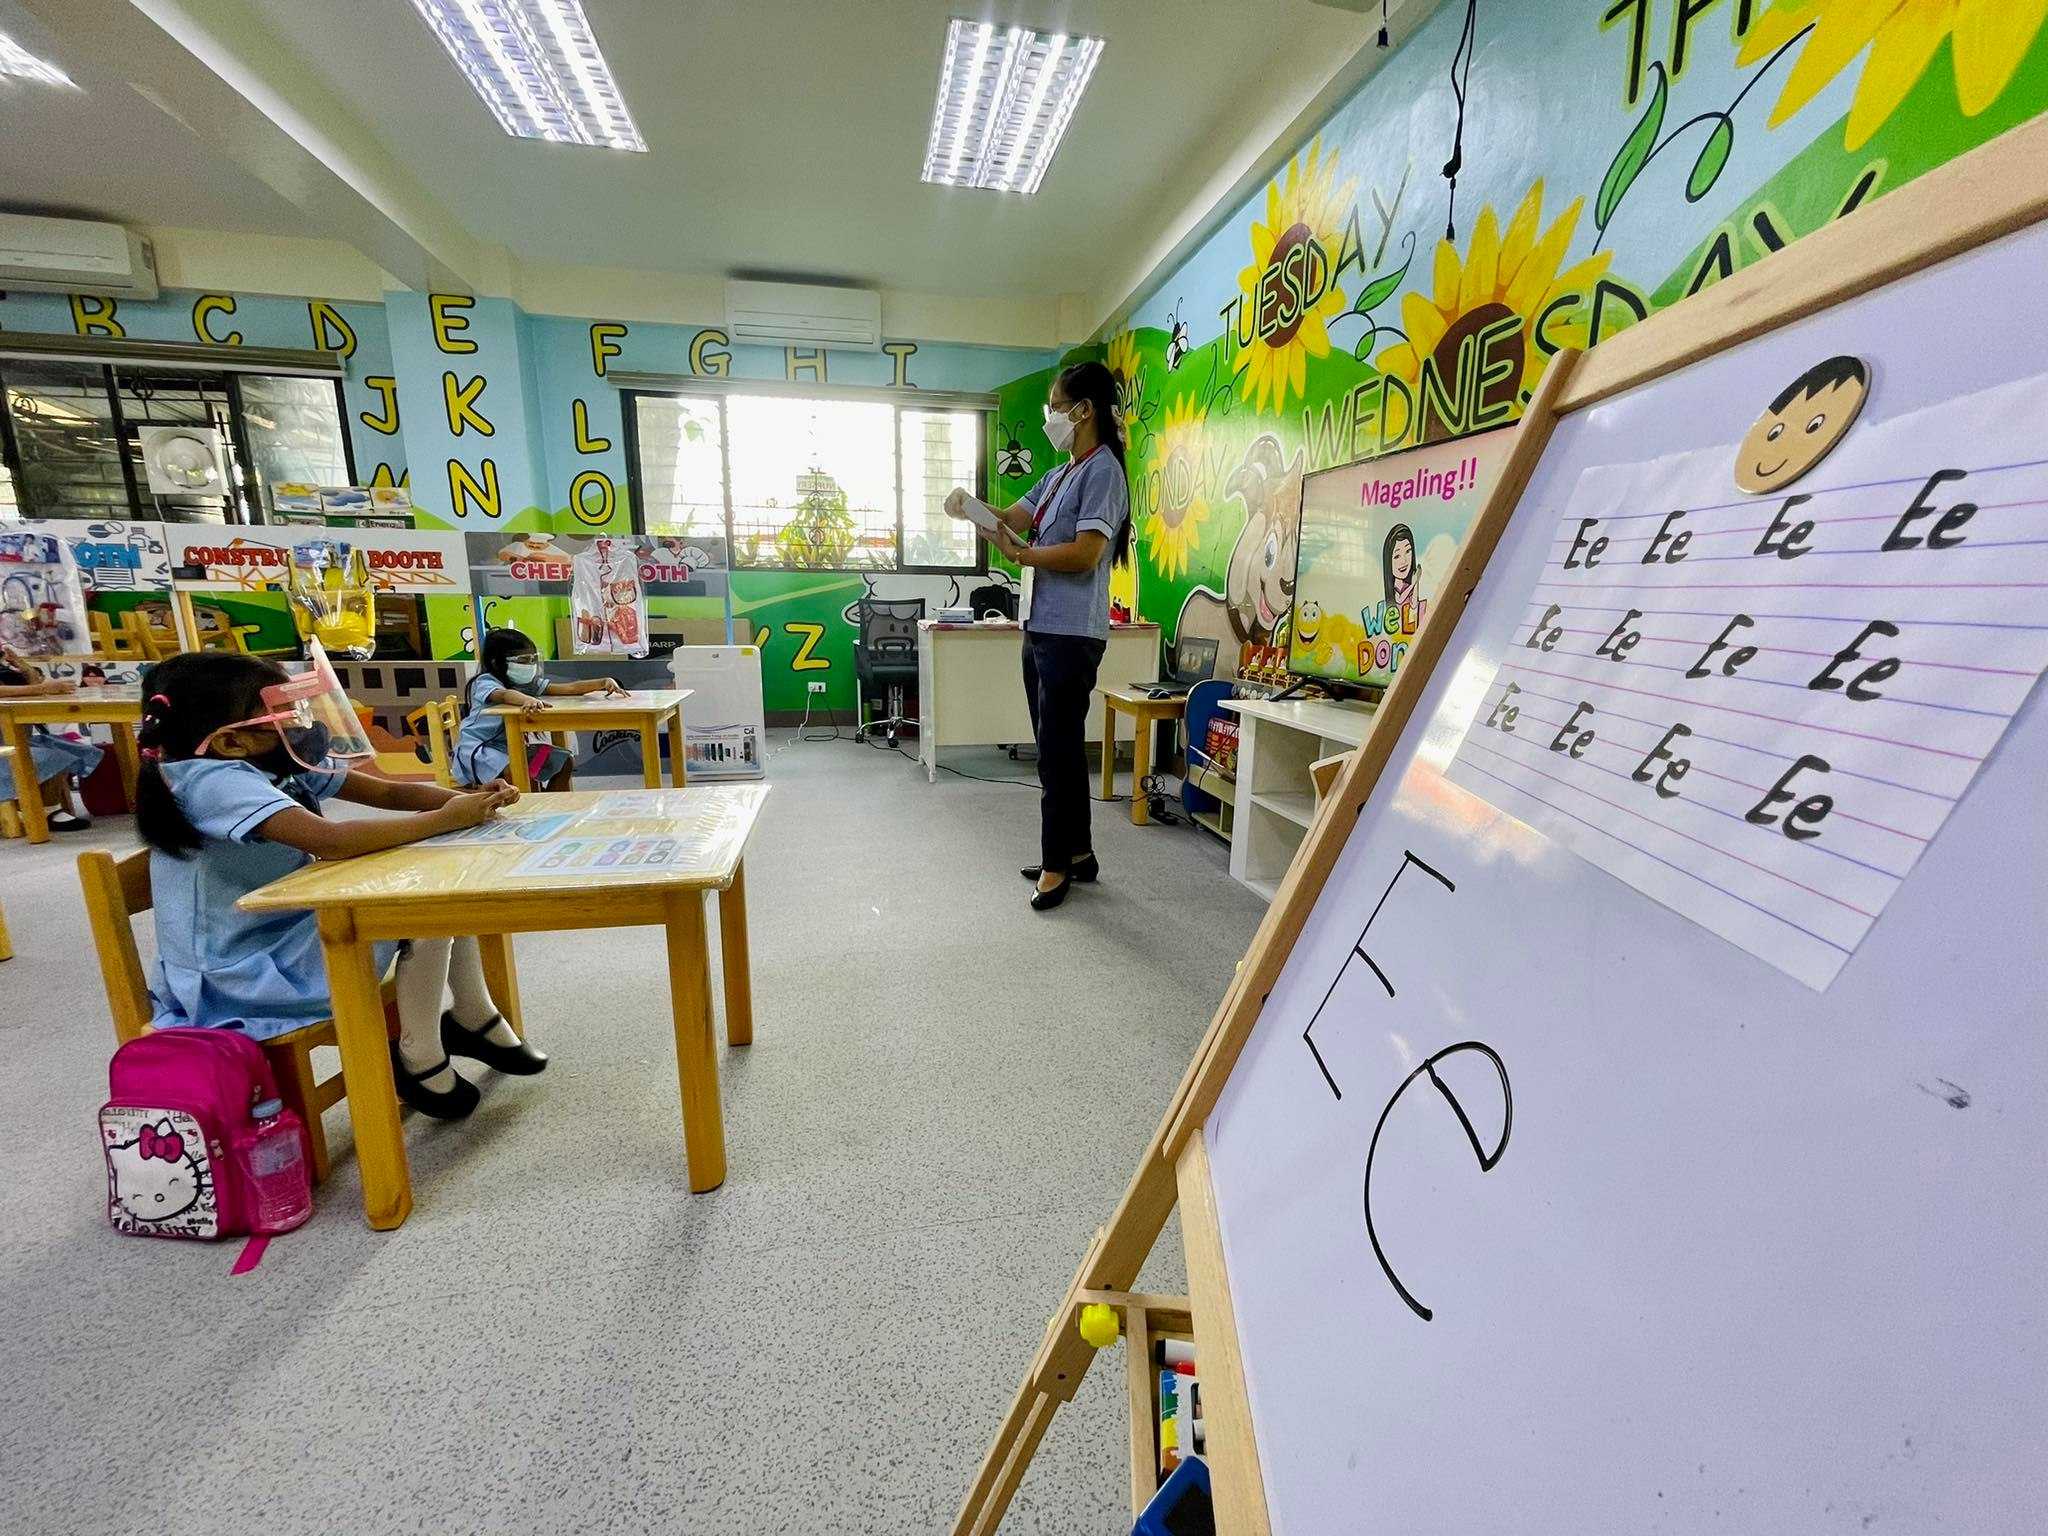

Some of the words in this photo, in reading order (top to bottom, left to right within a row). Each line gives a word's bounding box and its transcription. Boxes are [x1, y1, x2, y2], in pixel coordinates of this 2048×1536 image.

[1219, 163, 1410, 363] TUESDAY
[67, 292, 126, 338] B
[192, 294, 243, 346] C
[308, 298, 358, 360] D
[428, 292, 479, 355] E
[589, 322, 629, 378] F
[688, 329, 732, 377] G
[786, 346, 829, 383] H
[881, 342, 918, 389] I
[360, 375, 400, 435] J
[442, 370, 496, 437] K
[571, 398, 612, 455] L
[446, 458, 502, 519] N
[569, 469, 616, 527] O
[1131, 443, 1229, 520] MONDAY
[1359, 456, 1478, 509] Magaling!!
[1563, 518, 1610, 570] Ee
[1641, 510, 1694, 565] Ee
[1753, 494, 1816, 561] Ee
[1880, 468, 1979, 553] Ee
[366, 549, 444, 570] BOOTH
[639, 562, 691, 583] OTH
[785, 622, 831, 672] Z
[1525, 604, 1563, 653] Ee
[1596, 609, 1642, 663] Ee
[1686, 614, 1758, 679] Ee
[1808, 620, 1902, 702] Ee
[1486, 682, 1522, 733] Ee
[1549, 701, 1596, 760] Ee
[1631, 723, 1693, 799] Ee
[1744, 754, 1835, 841] Ee
